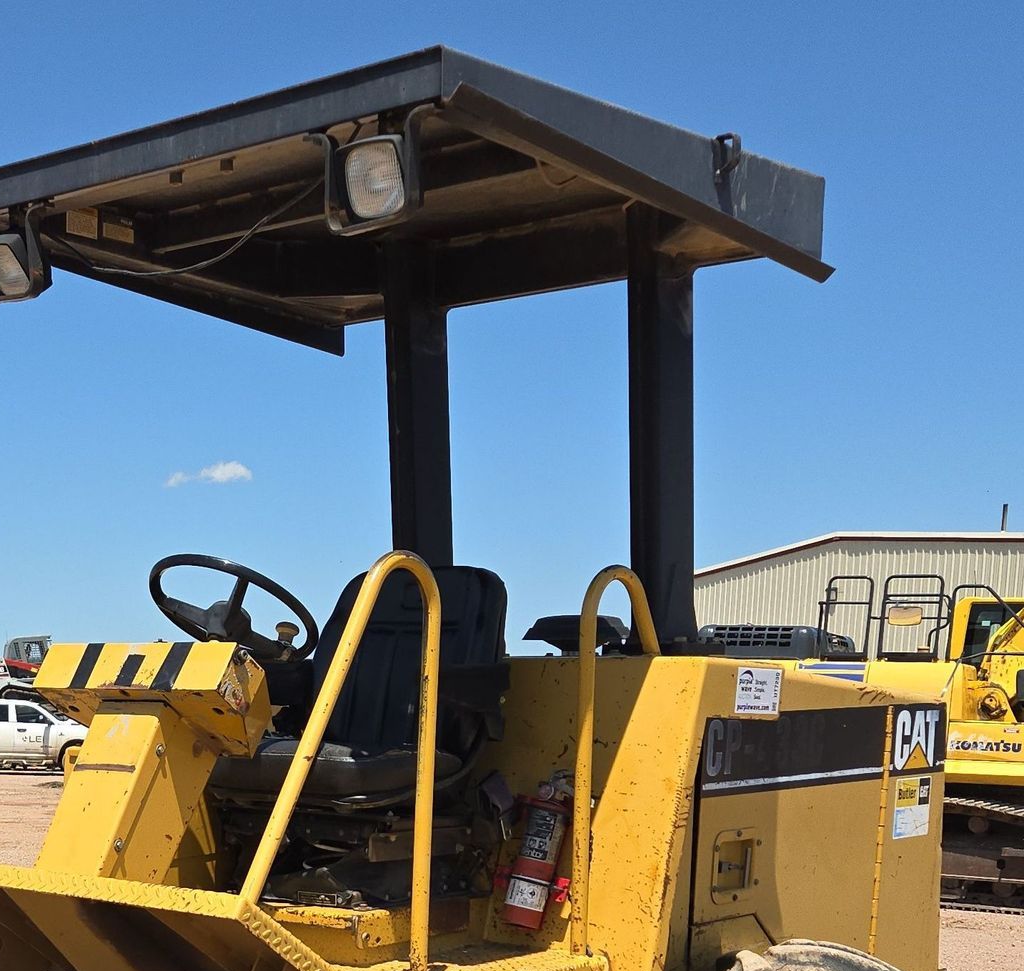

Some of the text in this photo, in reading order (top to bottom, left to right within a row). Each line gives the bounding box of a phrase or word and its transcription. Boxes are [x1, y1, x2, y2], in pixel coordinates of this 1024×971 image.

[894, 709, 940, 770] CAT
[950, 739, 1023, 752] KOMATSU
[898, 787, 917, 800] Butler
